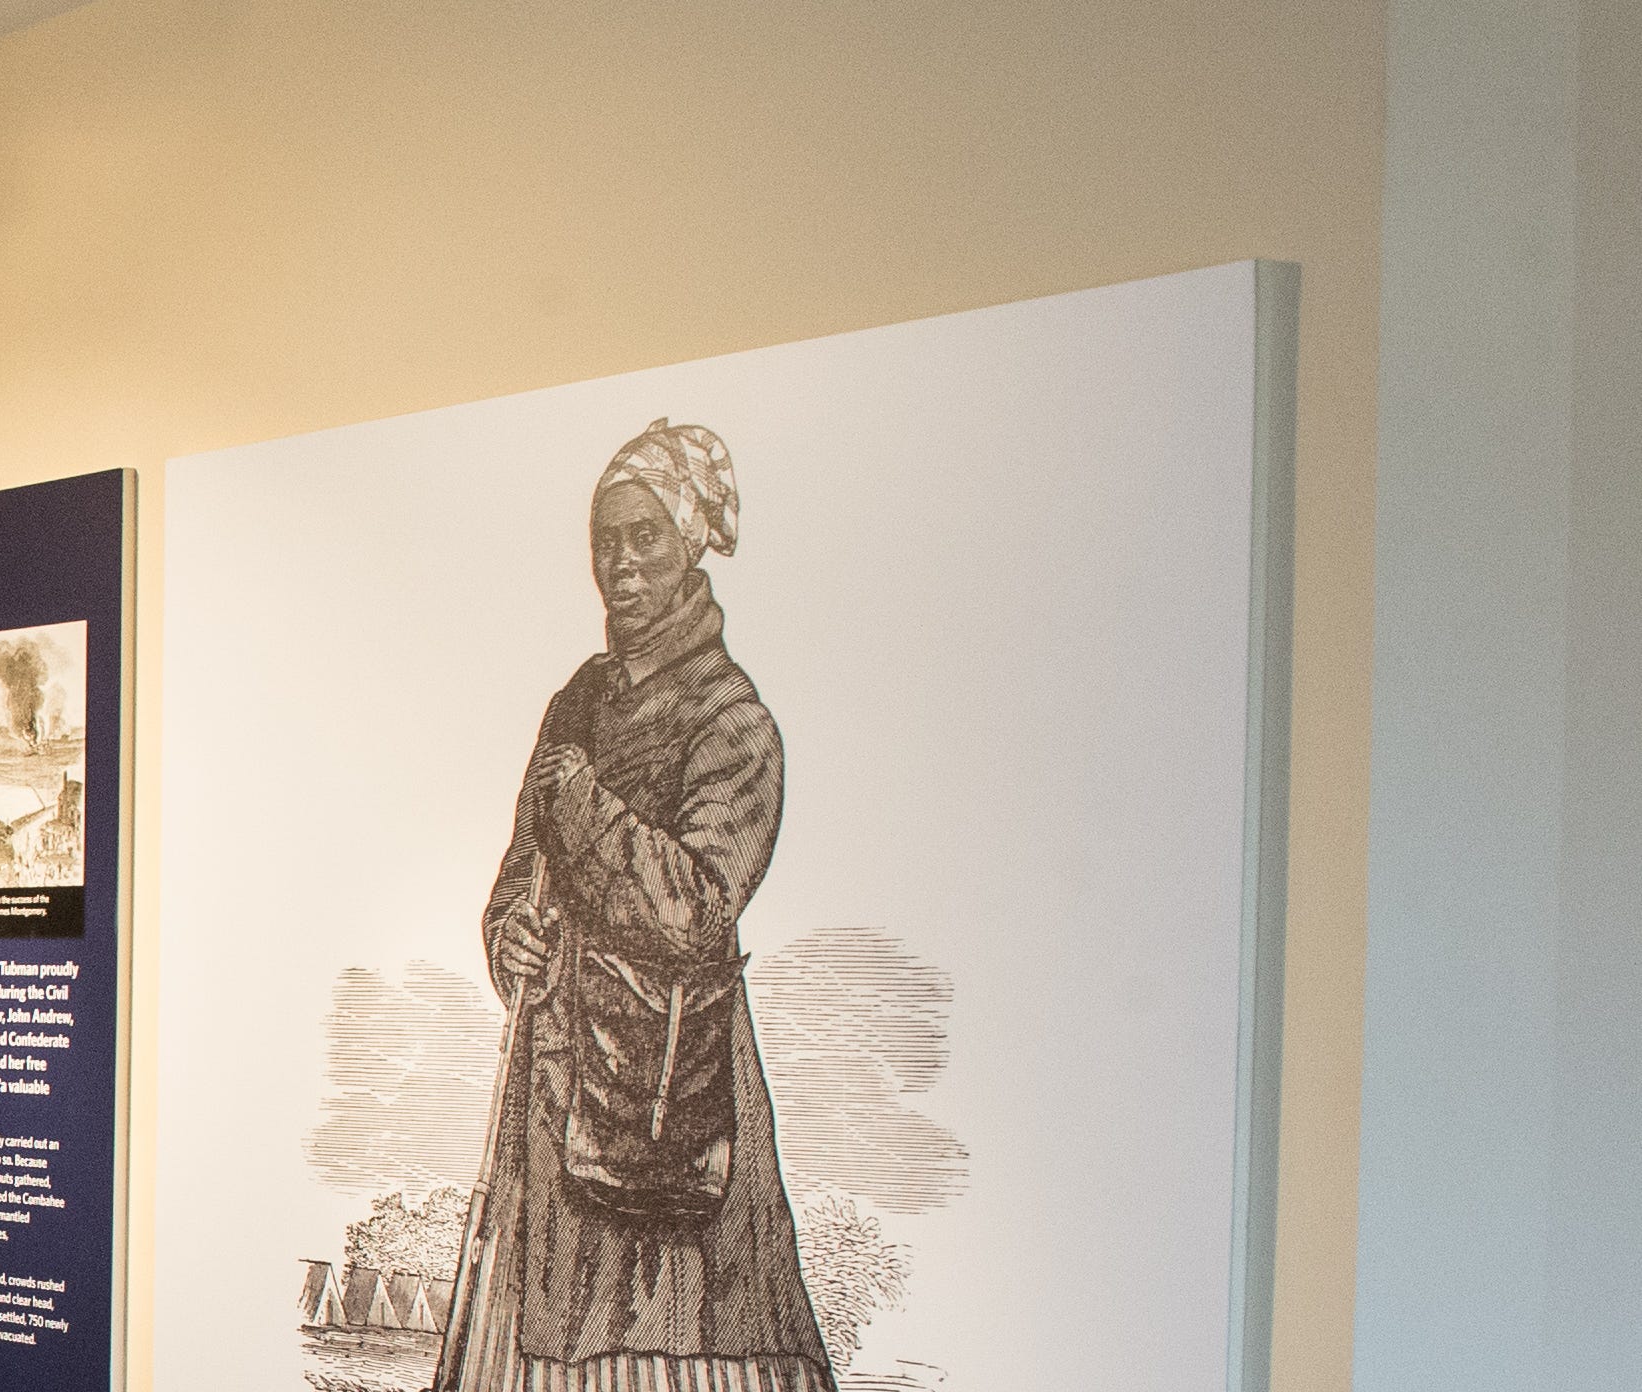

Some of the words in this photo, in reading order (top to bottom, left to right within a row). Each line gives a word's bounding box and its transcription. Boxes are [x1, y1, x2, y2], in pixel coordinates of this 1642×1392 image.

[0, 961, 38, 976] Tubman
[40, 961, 79, 979] proudly
[28, 985, 44, 999] the
[46, 985, 68, 1000] Civil
[7, 1008, 30, 1023] John
[32, 1009, 74, 1026] Andrew,
[9, 1032, 69, 1048] Confederate
[8, 1055, 24, 1070] her
[26, 1055, 46, 1071] free
[9, 1079, 50, 1095] valuable
